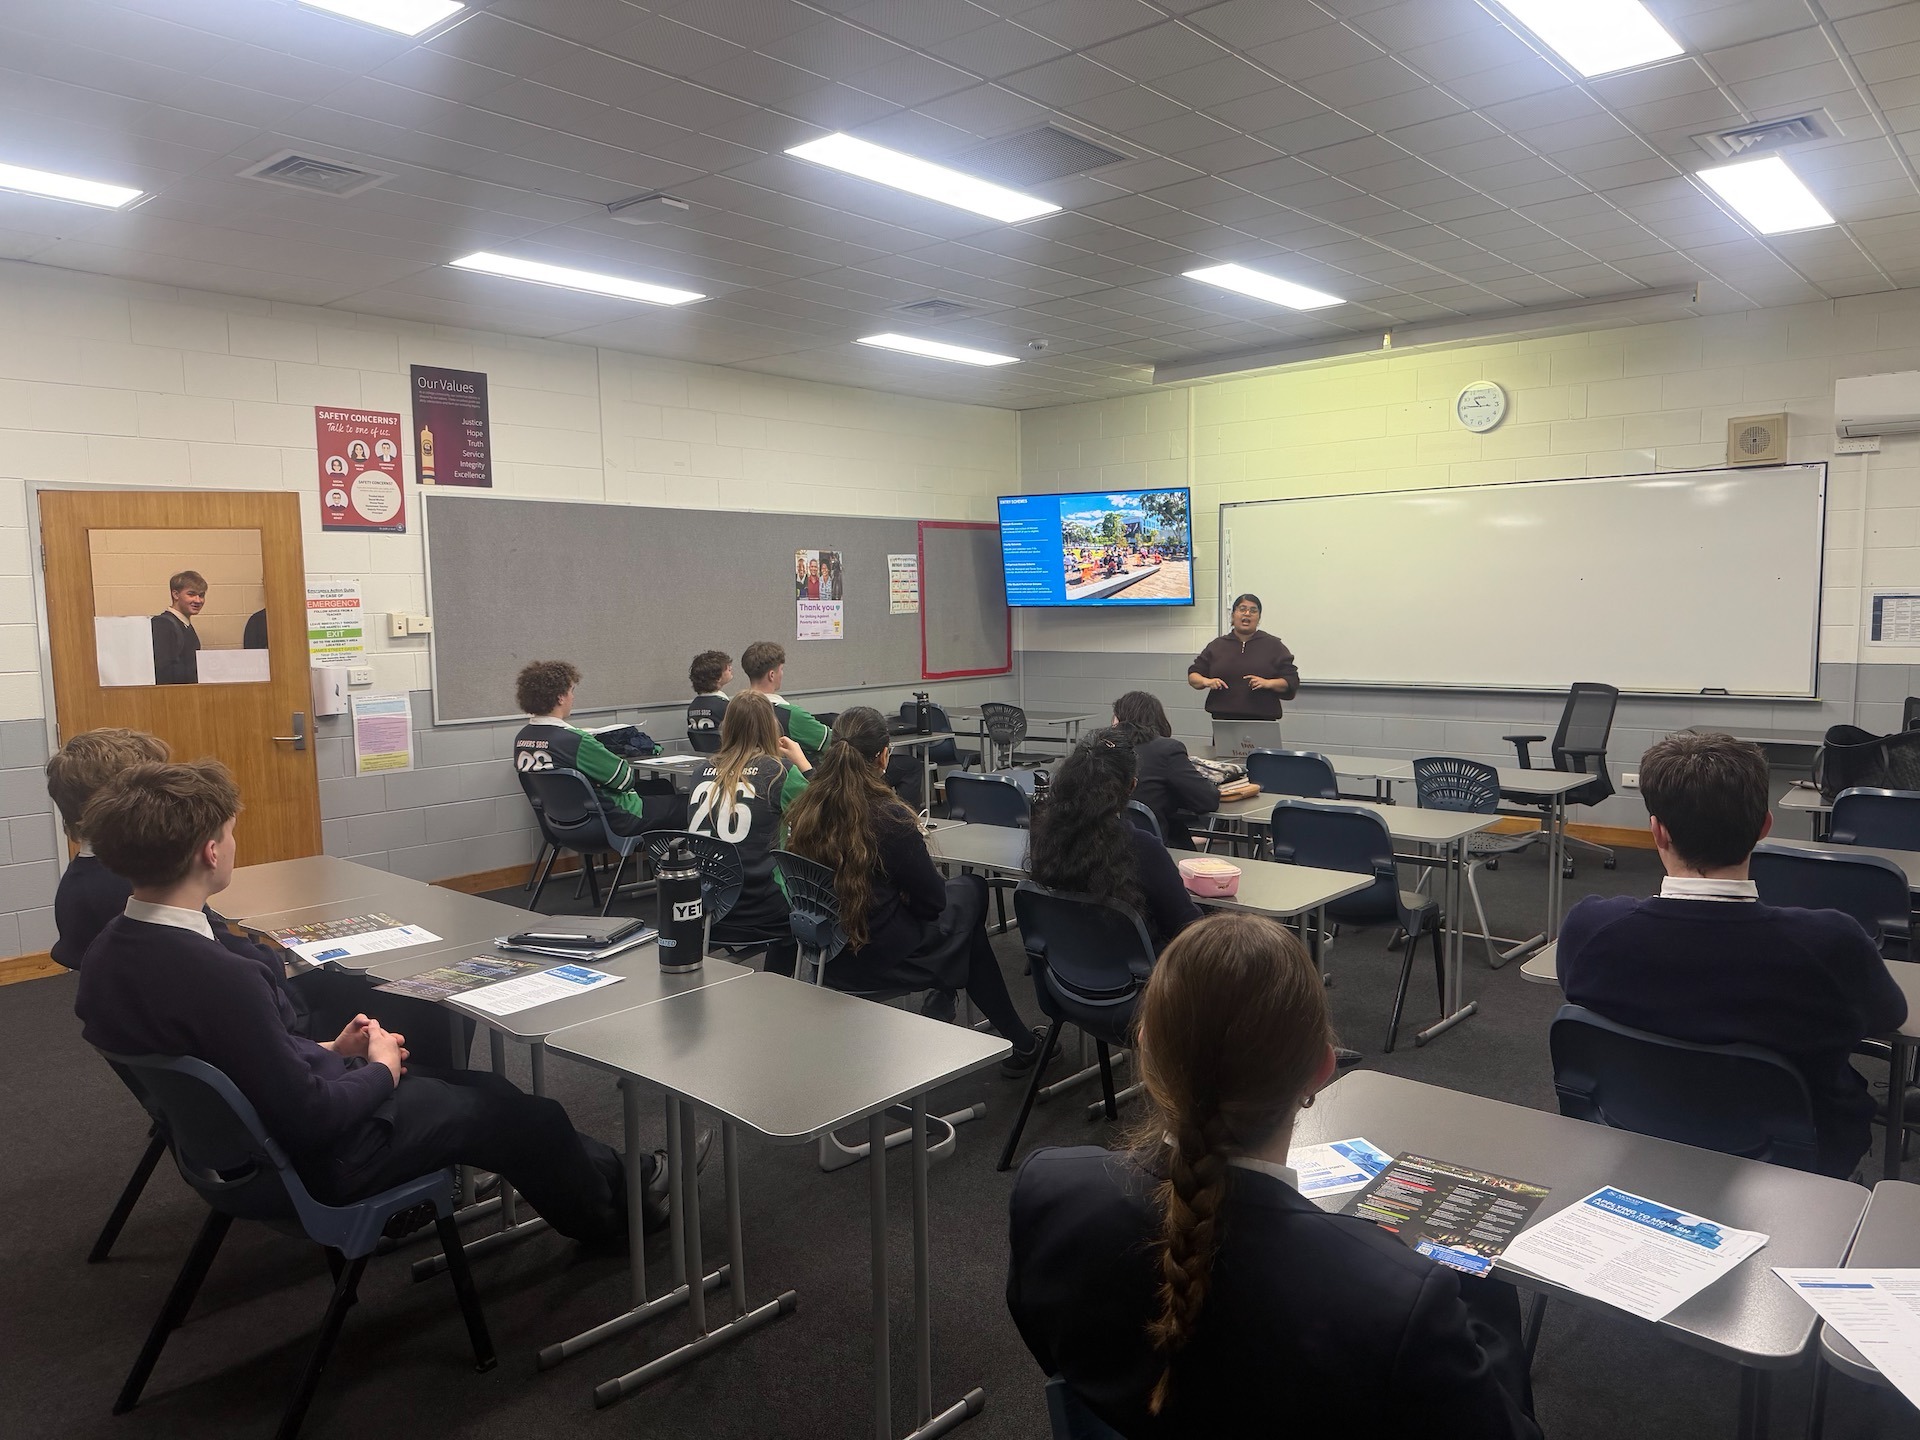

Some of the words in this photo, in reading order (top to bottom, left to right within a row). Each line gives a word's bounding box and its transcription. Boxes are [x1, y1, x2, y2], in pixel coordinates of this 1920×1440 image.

[418, 377, 438, 389] Our
[440, 380, 475, 394] Values
[319, 411, 350, 420] SAFETY
[350, 414, 398, 426] CONCERNS?
[462, 419, 483, 428] Justice
[327, 422, 344, 432] Talk
[370, 427, 378, 438] of
[466, 430, 484, 438] Hope
[468, 440, 484, 448] Truth
[462, 450, 485, 459] Service
[460, 461, 486, 470] Integrity
[454, 471, 486, 480] Excellence
[307, 600, 358, 608] EMERGENCY
[822, 604, 834, 612] you
[689, 781, 756, 843] 26
[1592, 1200, 1630, 1217] TASMANIAN
[1594, 1198, 1636, 1215] APPLYING
[1638, 1212, 1651, 1220] TO
[1650, 1216, 1692, 1234] MONASH
